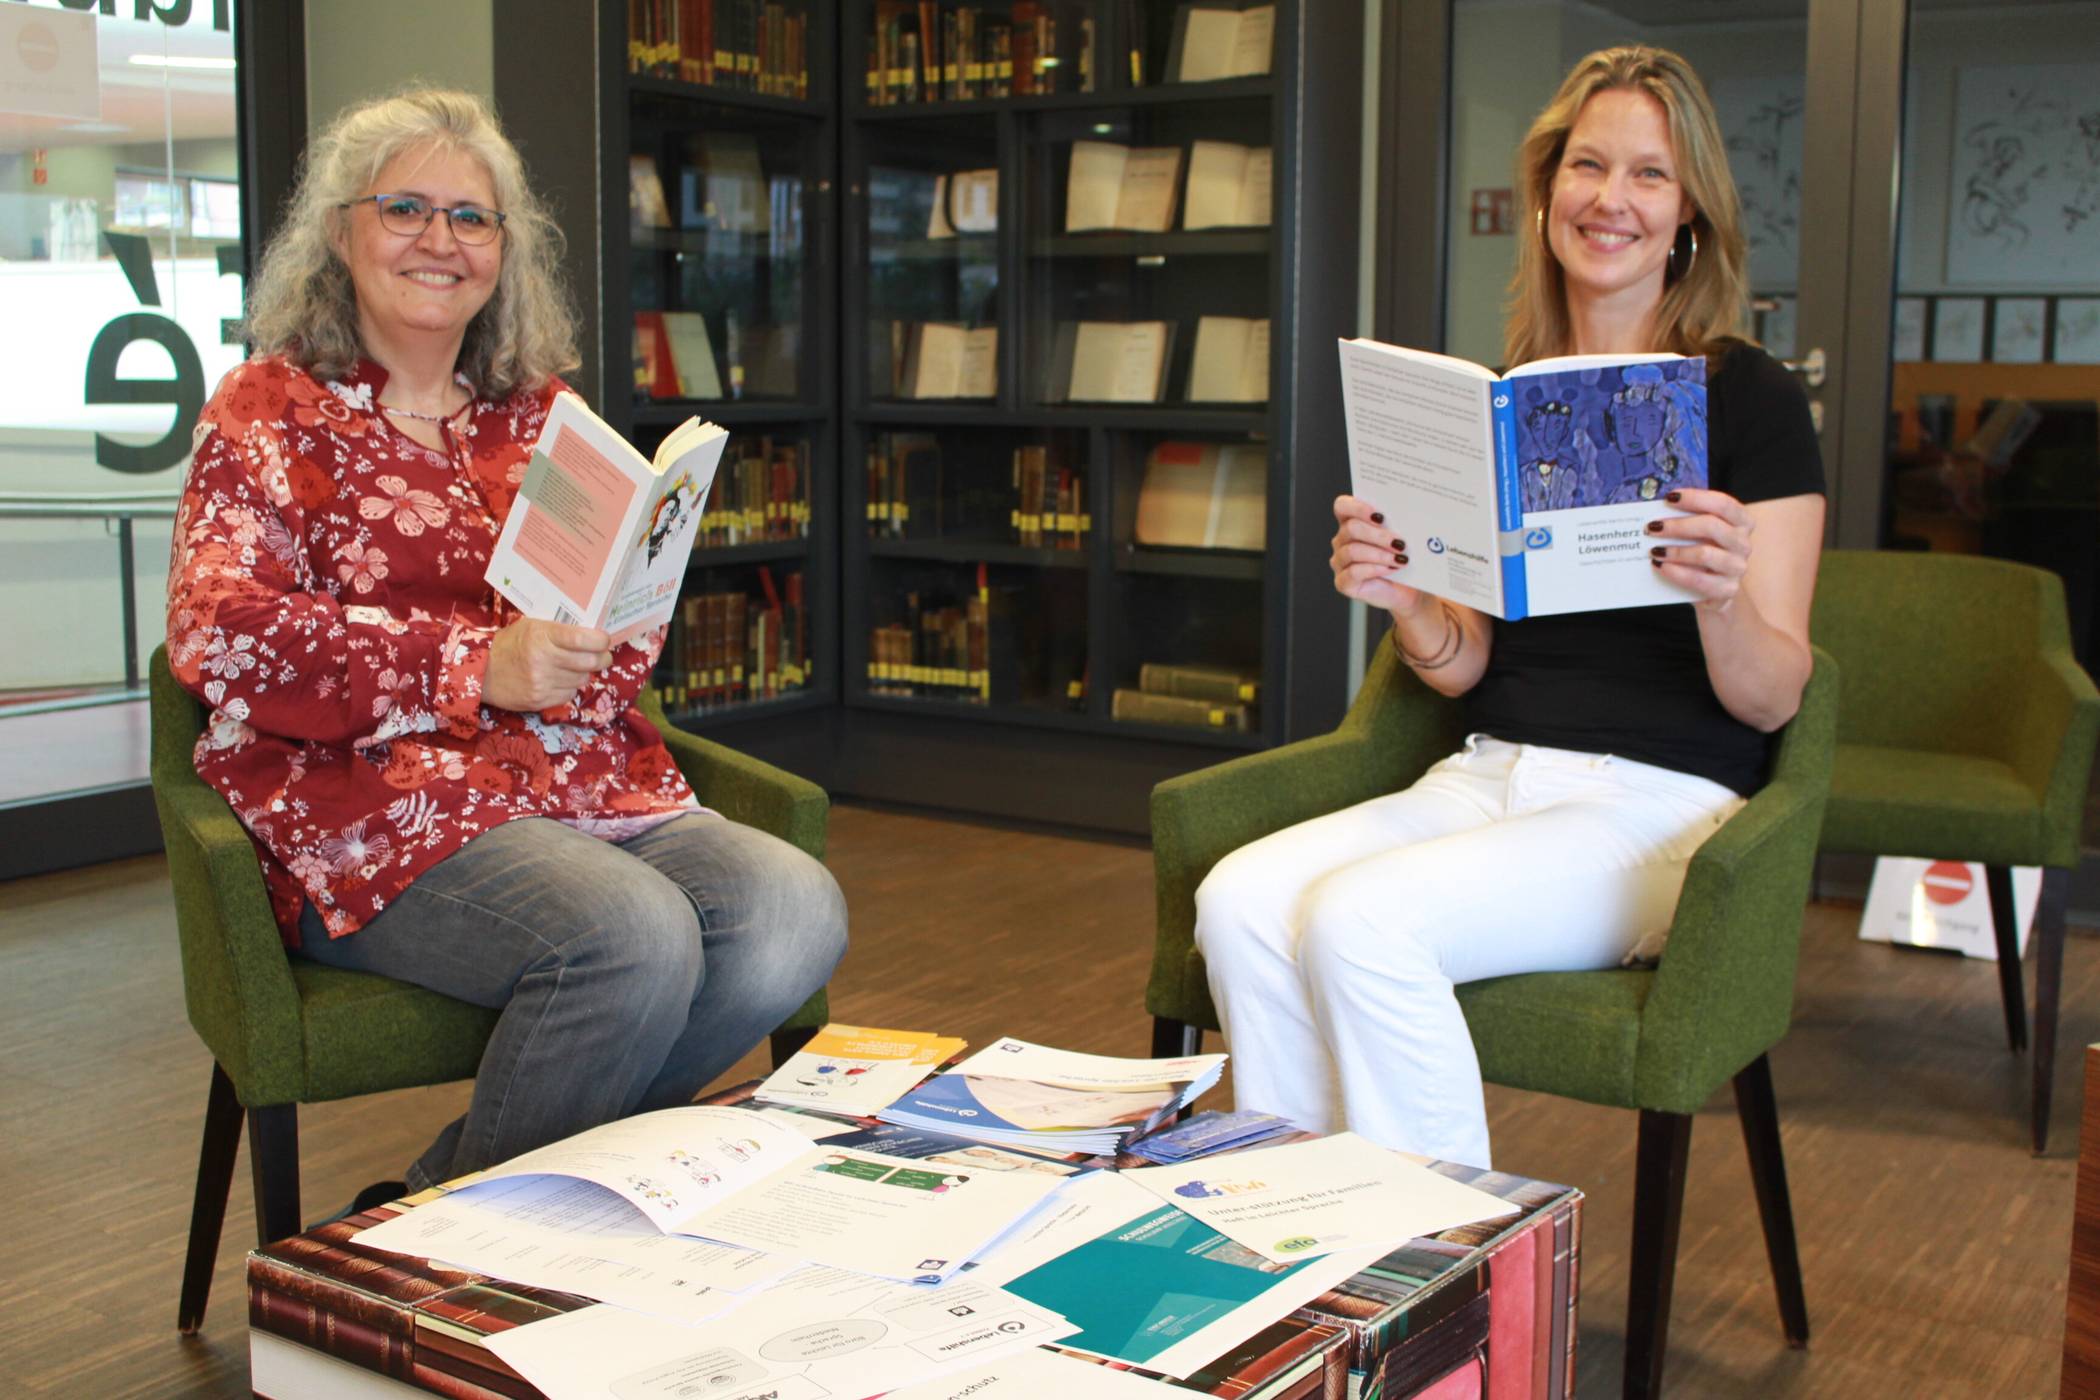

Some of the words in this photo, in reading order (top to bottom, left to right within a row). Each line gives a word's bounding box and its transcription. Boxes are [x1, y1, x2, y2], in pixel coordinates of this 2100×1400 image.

[1577, 529, 1641, 542] Hasenherz
[1578, 541, 1641, 555] Löwenmut
[656, 576, 677, 596] Böll
[1307, 1190, 1327, 1202] für
[1328, 1180, 1383, 1198] Familien
[1283, 1236, 1319, 1250] efa
[938, 1330, 1000, 1352] Lebenshilfe
